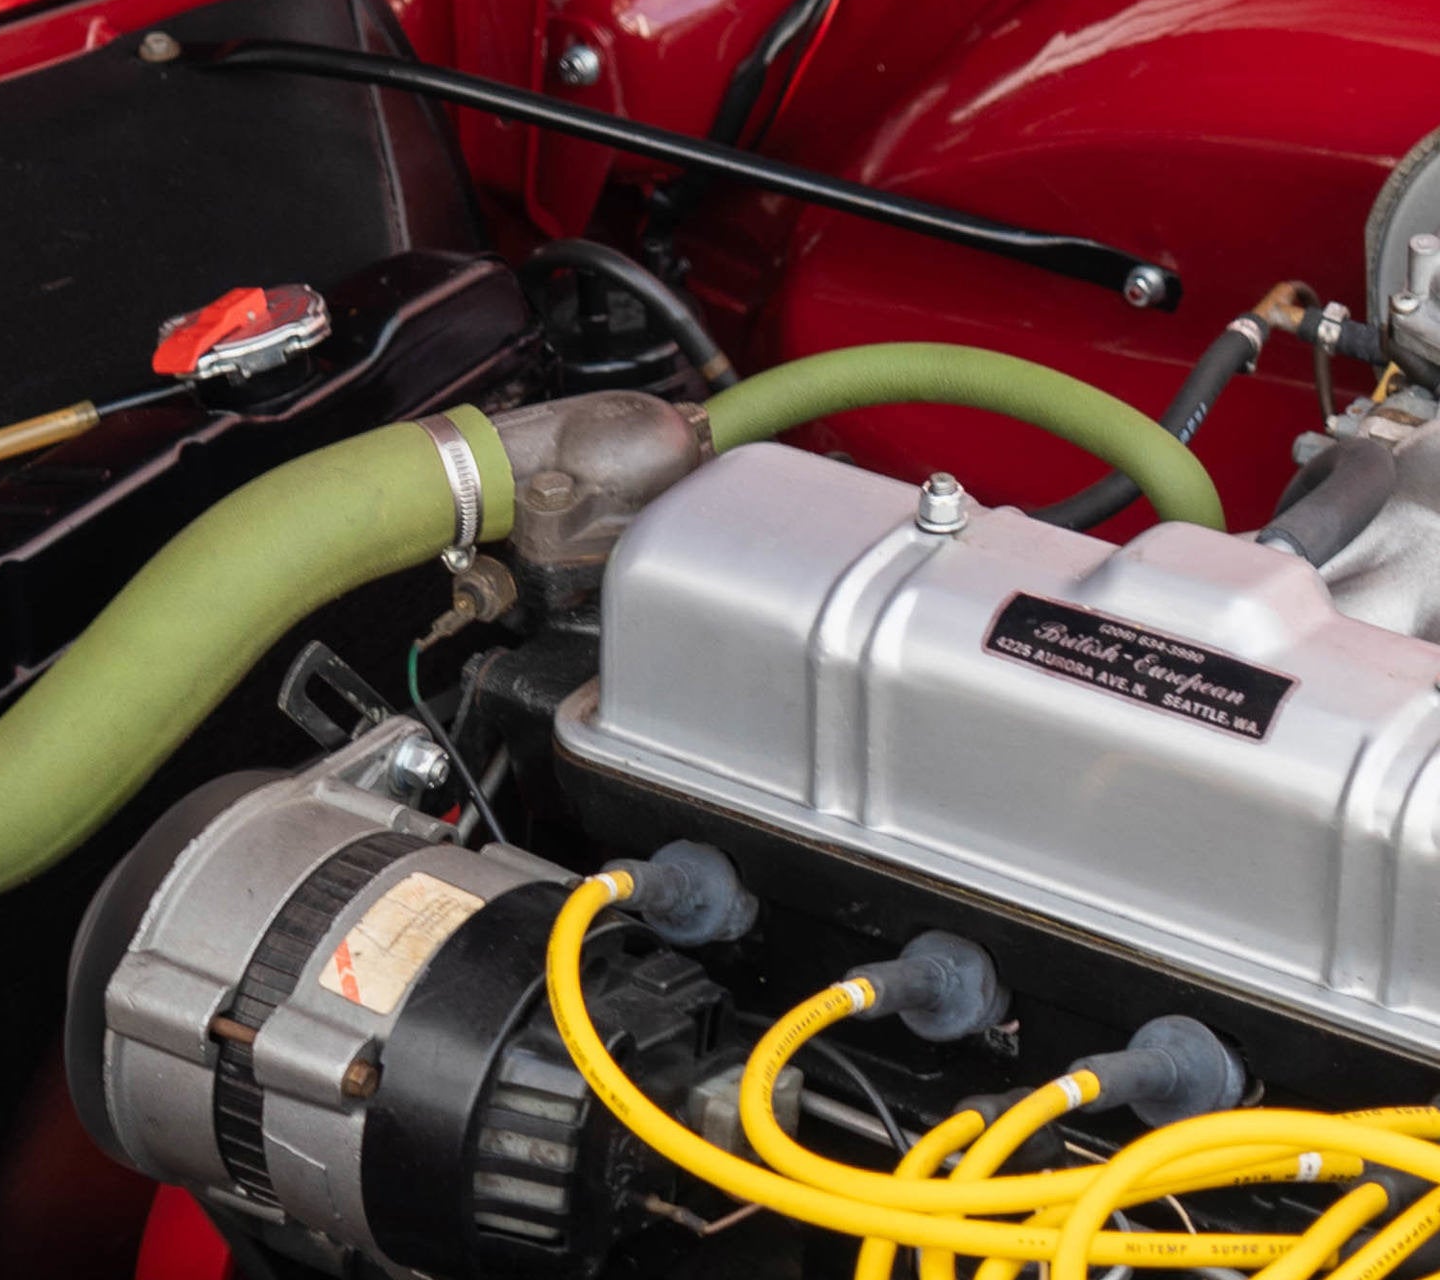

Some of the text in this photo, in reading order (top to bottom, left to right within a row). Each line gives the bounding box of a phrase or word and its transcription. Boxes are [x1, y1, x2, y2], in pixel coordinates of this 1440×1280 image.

[1034, 648, 1094, 680] AURORA
[1095, 669, 1130, 692] AVE.
[1211, 1243, 1260, 1256] SUPER
